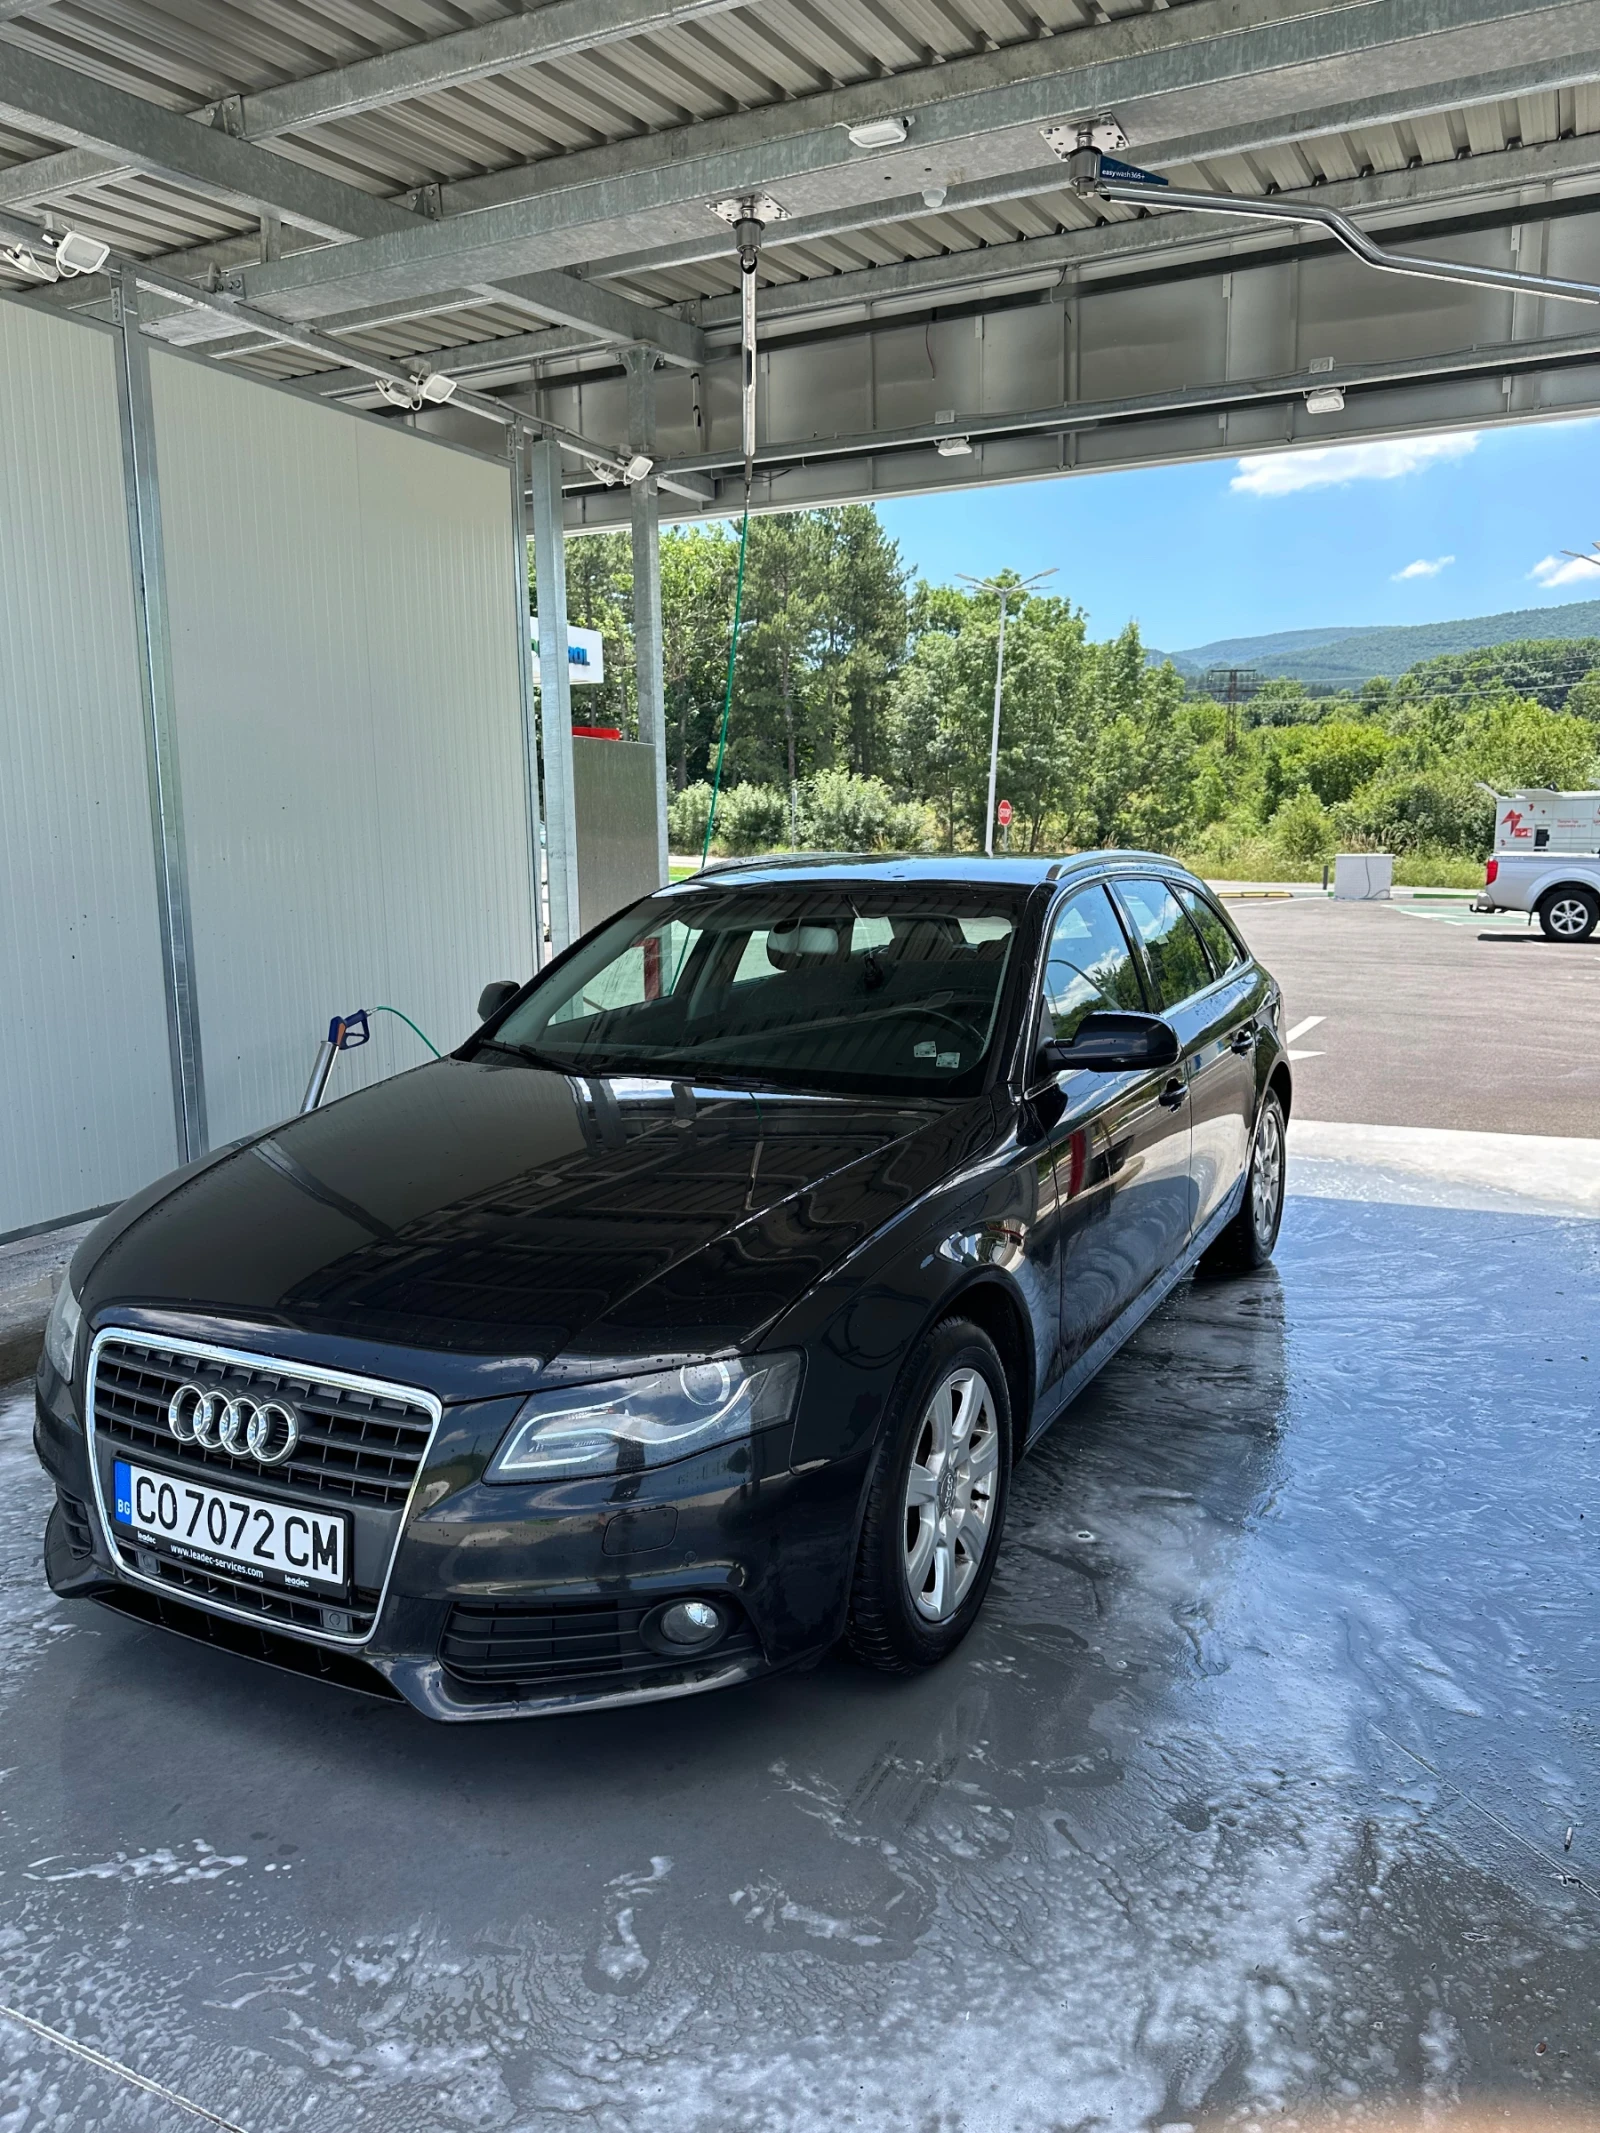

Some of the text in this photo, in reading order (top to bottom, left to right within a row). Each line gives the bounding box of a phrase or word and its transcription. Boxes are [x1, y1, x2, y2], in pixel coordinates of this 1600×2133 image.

[1102, 169, 1145, 180] easywash365+
[117, 1499, 131, 1516] BG
[137, 1530, 156, 1545] leadec
[185, 1489, 275, 1561] 7072
[284, 1515, 339, 1576] CM
[170, 1544, 264, 1579] www.leadec-services.com
[284, 1574, 310, 1588] leadec
